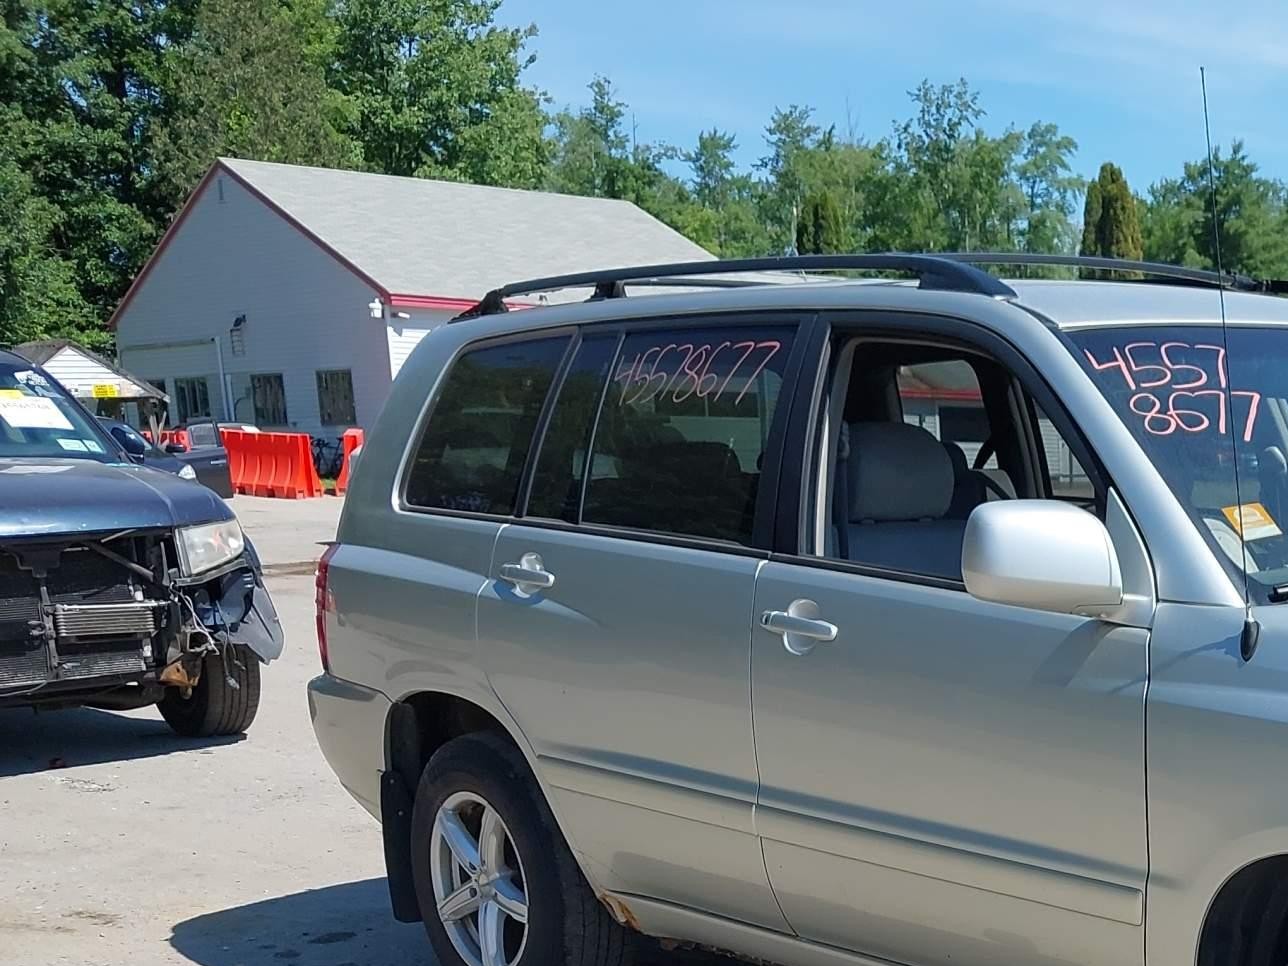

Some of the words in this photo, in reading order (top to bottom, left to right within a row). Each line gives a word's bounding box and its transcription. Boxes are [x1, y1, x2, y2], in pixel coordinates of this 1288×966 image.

[613, 340, 781, 407] 45578677
[1083, 341, 1227, 391] 4557
[1129, 389, 1261, 443] 8677
